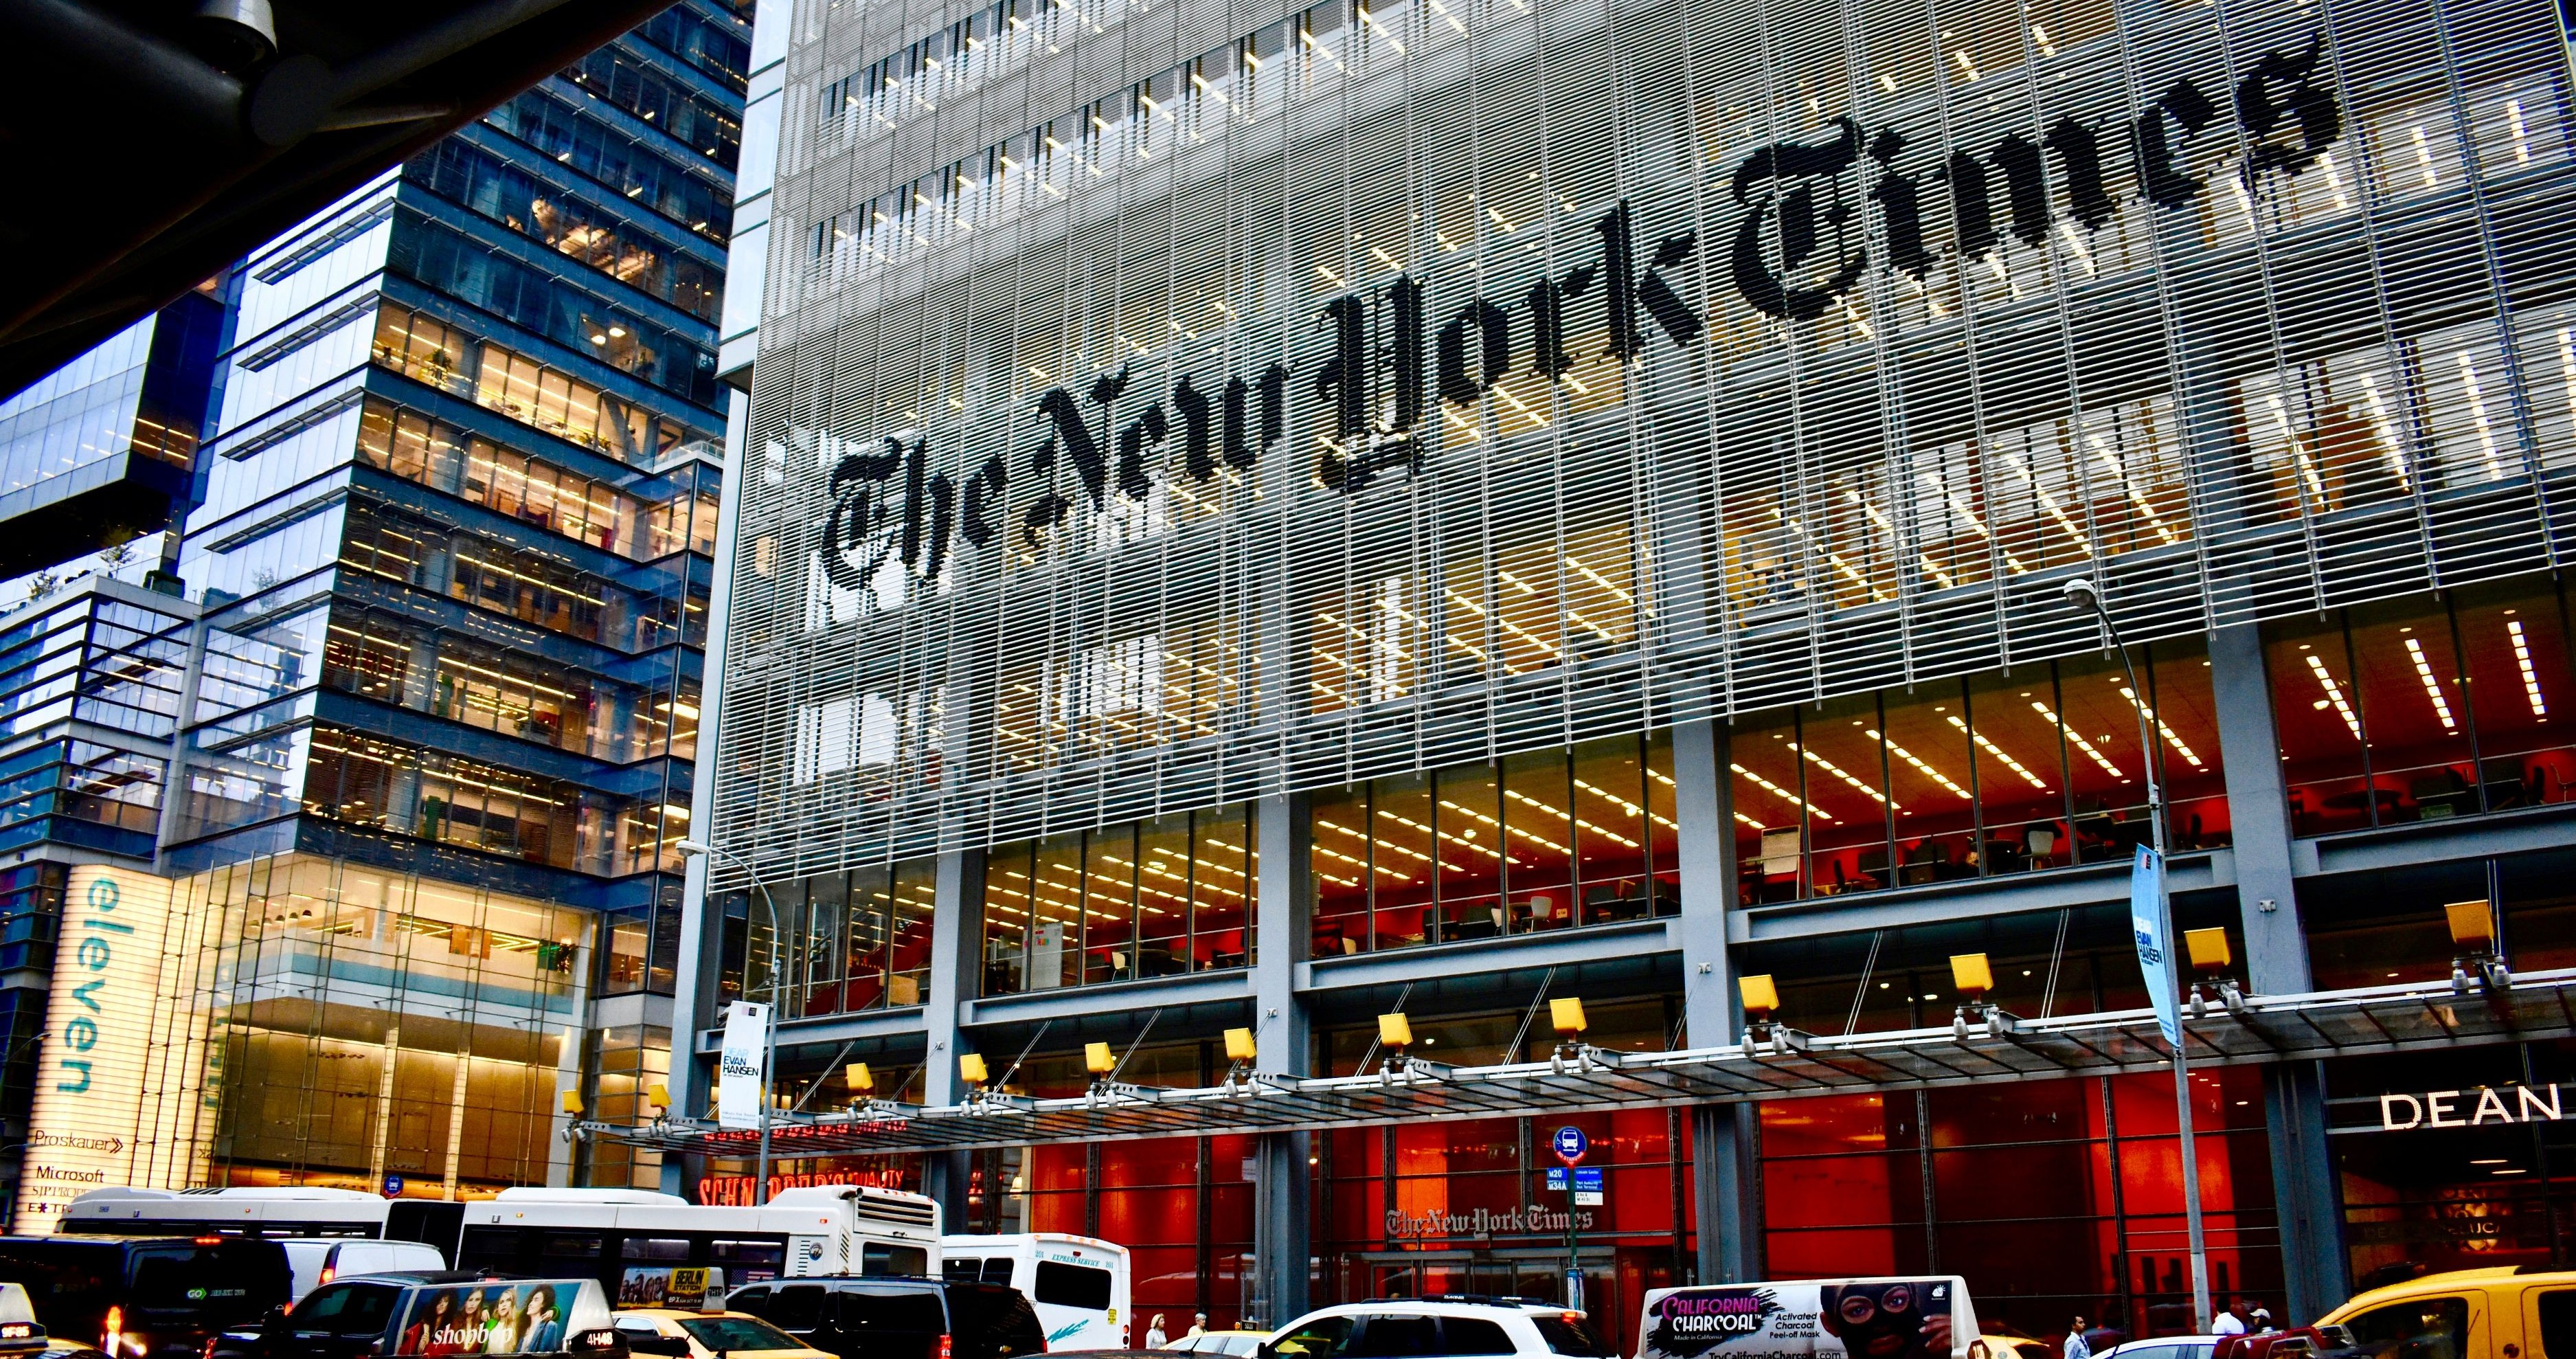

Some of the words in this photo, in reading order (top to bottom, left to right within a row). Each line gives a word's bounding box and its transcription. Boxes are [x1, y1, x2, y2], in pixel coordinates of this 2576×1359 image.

[822, 436, 1007, 589] The
[1023, 361, 1294, 547] New
[1312, 198, 1709, 494] York
[1730, 31, 2341, 320] Times
[2136, 930, 2152, 948] EVAN
[2138, 944, 2163, 964] HANSEN
[56, 877, 135, 1094] eleven
[724, 1046, 749, 1057] DEAR
[723, 1055, 747, 1066] EVAN
[722, 1064, 759, 1077] HANSEN
[2380, 1083, 2562, 1131] DEAN
[34, 1130, 110, 1151] Proskauer
[1563, 1151, 1584, 1161] STANDING
[36, 1165, 104, 1183] Microsoft
[1549, 1169, 1562, 1178] M20
[32, 1186, 52, 1198] SJP
[1548, 1182, 1567, 1190] M34A
[1386, 1209, 1427, 1237] The
[1426, 1208, 1469, 1234] New
[1469, 1205, 1524, 1240] York
[1526, 1204, 1593, 1231] Times
[1035, 1250, 1044, 1258] 201
[1052, 1254, 1077, 1263] EXPRESS
[1078, 1257, 1100, 1267] SERVICE
[675, 1270, 705, 1284] BERLIN
[188, 1290, 202, 1298] GO
[708, 1288, 723, 1296] 7H15
[1662, 1296, 1759, 1321] CALIFORNIA
[1776, 1312, 1818, 1321] Activated
[1776, 1321, 1815, 1329] Charcoal
[433, 1323, 514, 1352] shopbp
[587, 1332, 613, 1346] 4H48
[1708, 1350, 1842, 1359] TryCaliforniaCharcoal.com
